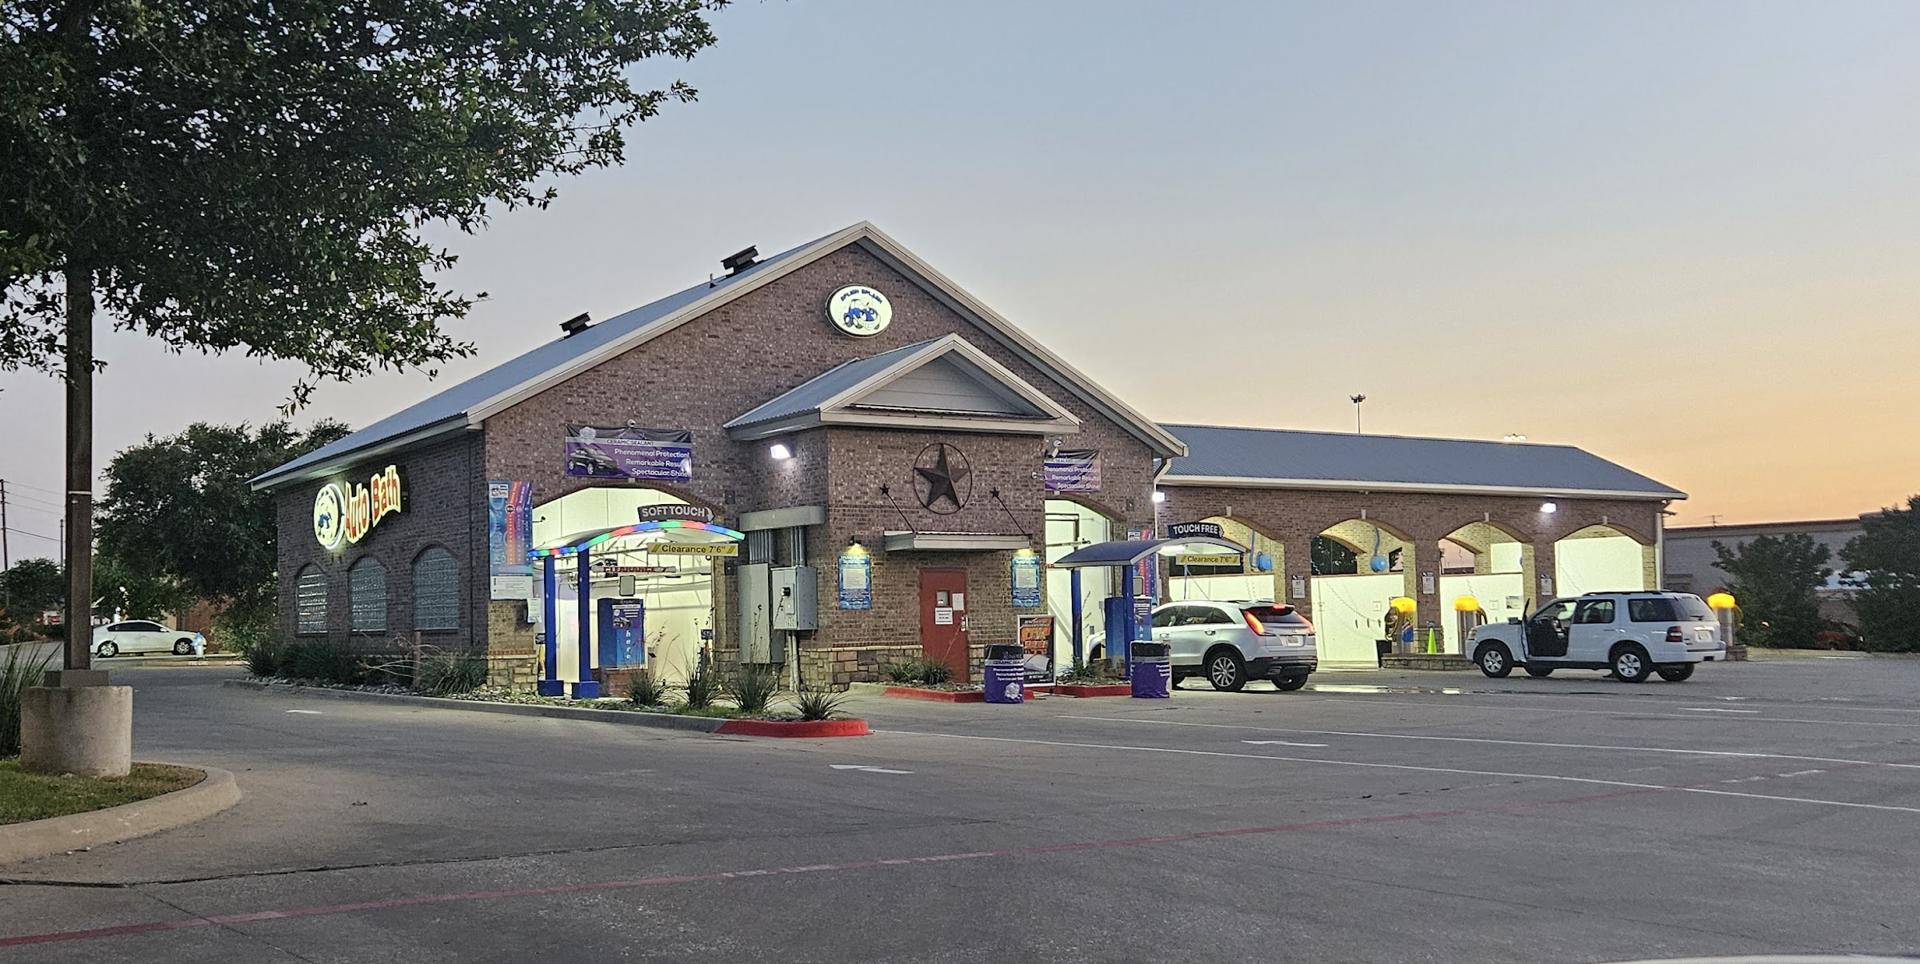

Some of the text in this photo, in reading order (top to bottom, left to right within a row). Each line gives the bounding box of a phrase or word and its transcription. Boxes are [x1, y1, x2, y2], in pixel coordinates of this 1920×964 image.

[614, 448, 655, 457] Phenomenal
[625, 458, 665, 467] Remarkable
[631, 467, 670, 476] Spectacular
[345, 465, 401, 543] Auto Bath
[641, 505, 705, 517] SOFT TOUCH
[1172, 523, 1218, 535] TOUCH FREE
[661, 544, 706, 553] Clearance
[1187, 555, 1219, 563] Clearance
